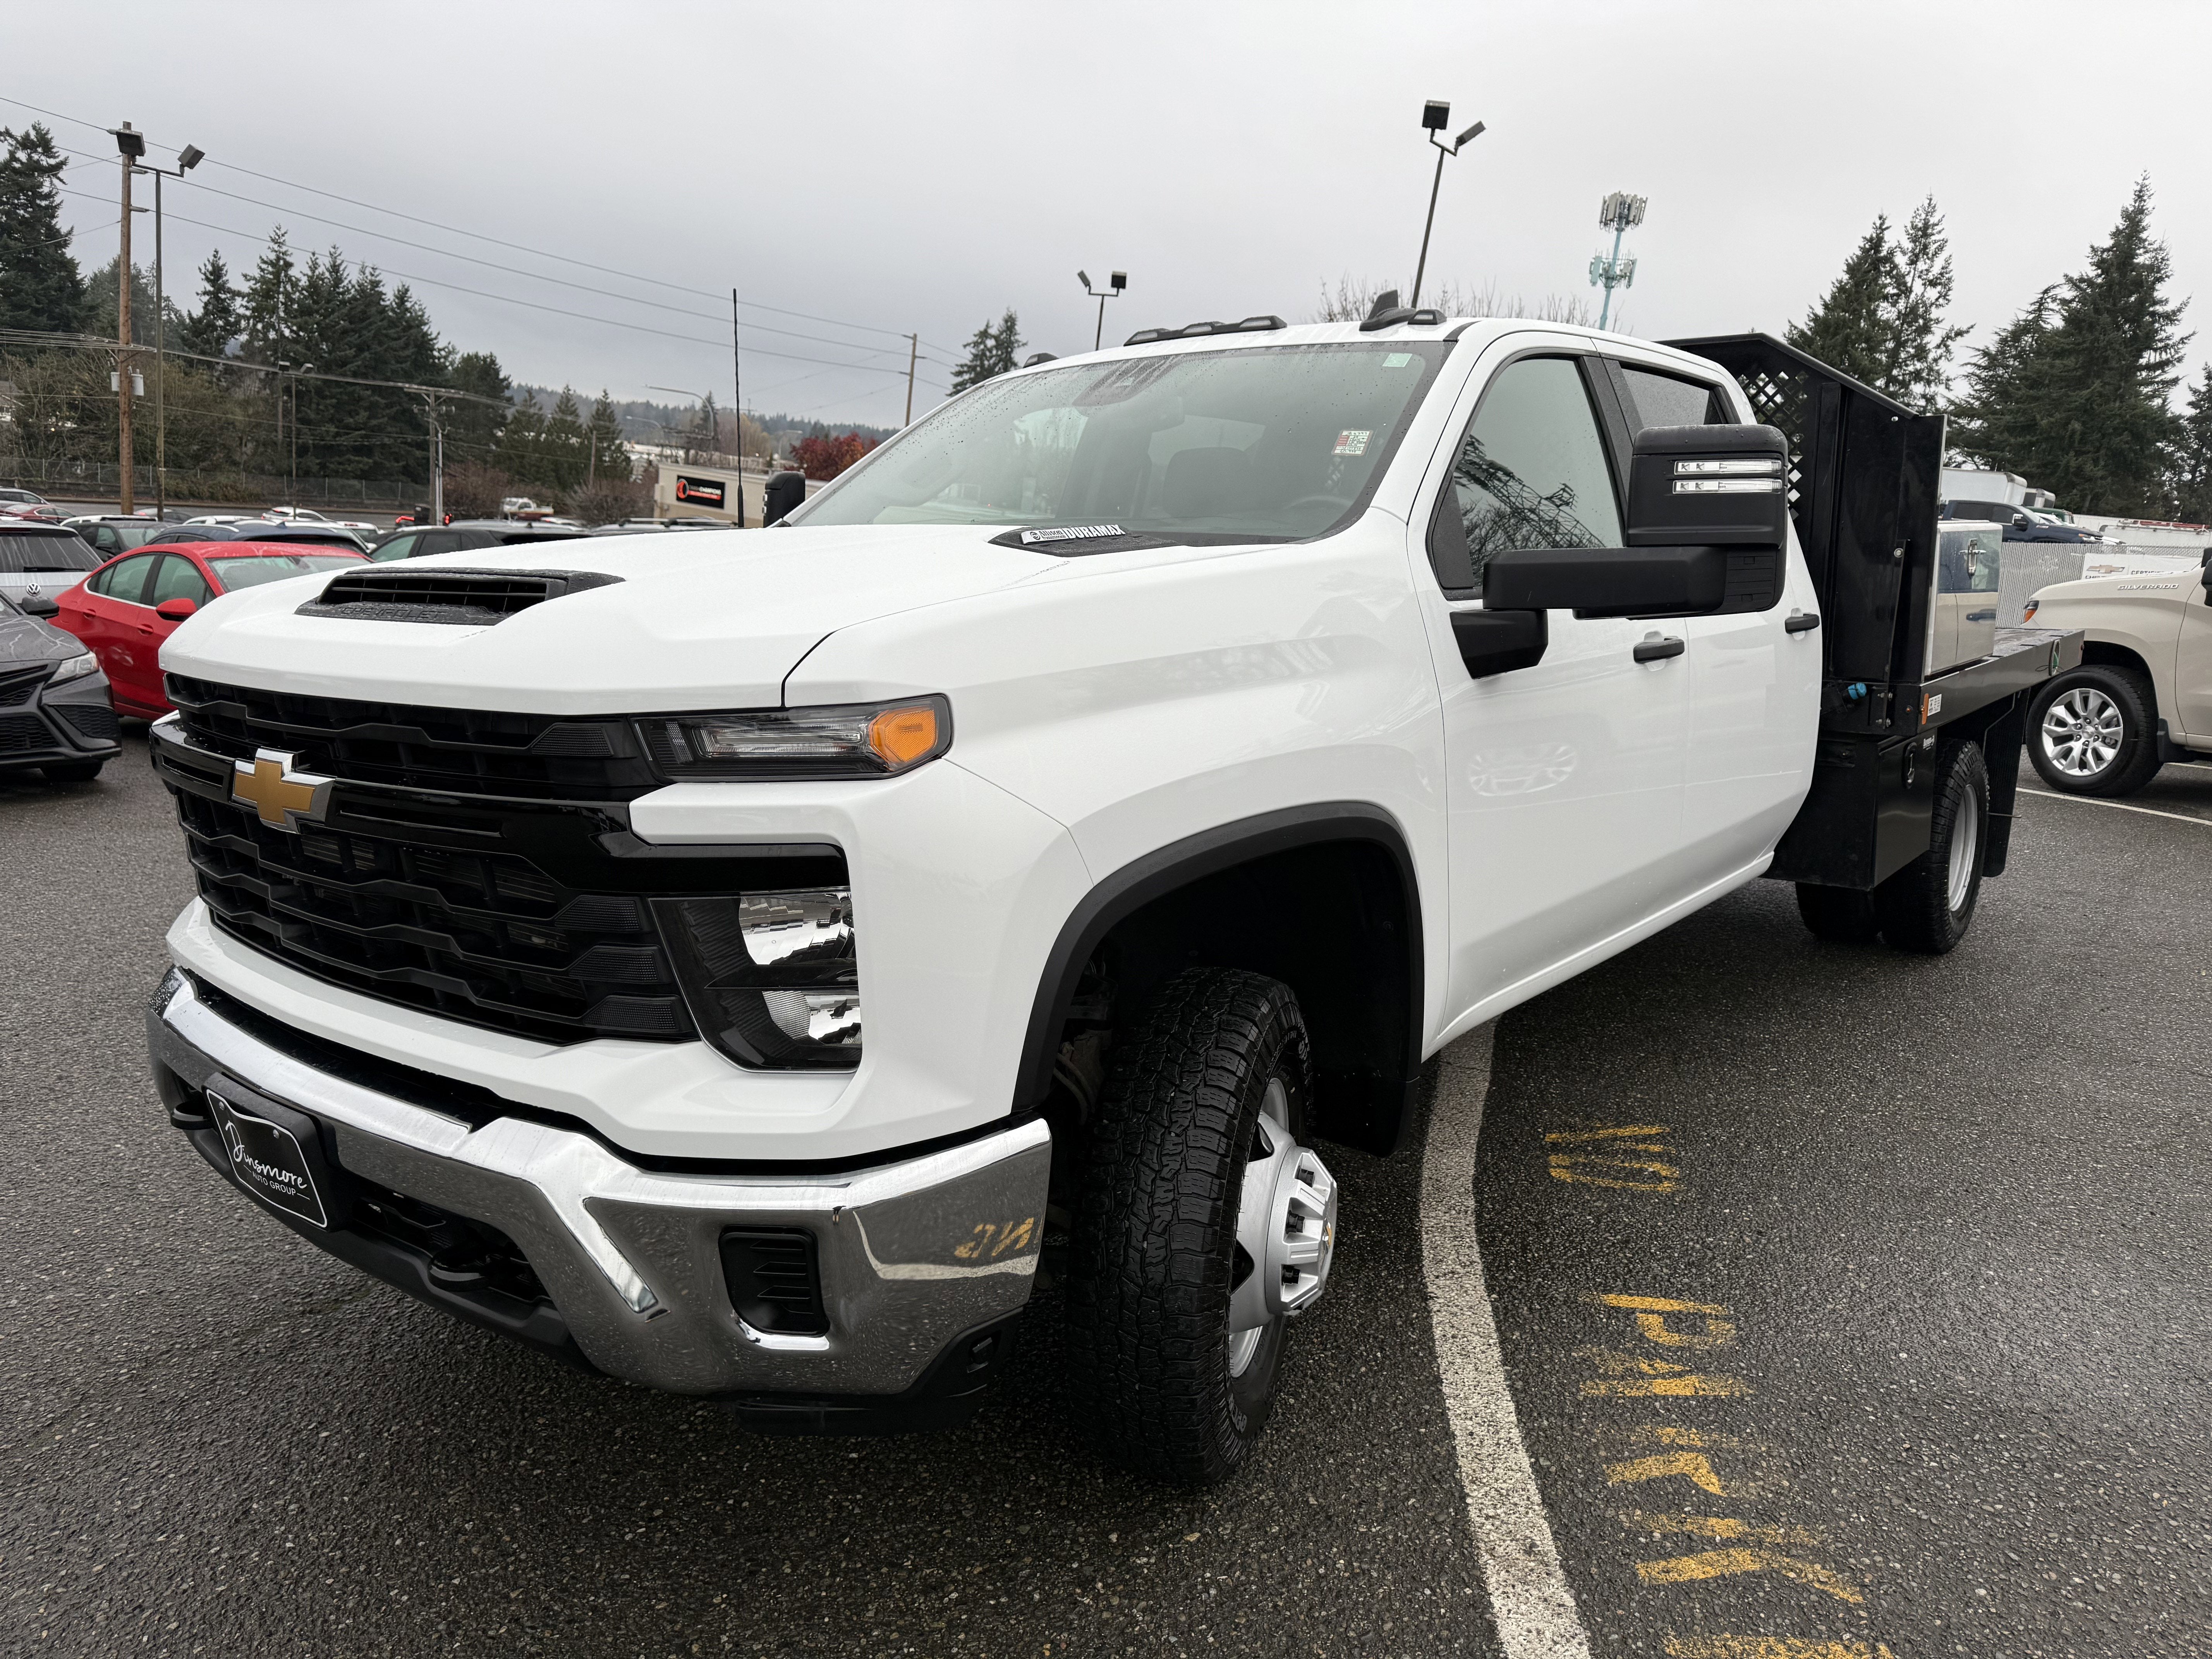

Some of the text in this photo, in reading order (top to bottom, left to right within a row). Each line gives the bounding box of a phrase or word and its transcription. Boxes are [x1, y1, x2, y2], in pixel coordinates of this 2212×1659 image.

[1063, 524, 1126, 539] DURAMAX
[225, 1120, 307, 1189] Dinsmore
[252, 1172, 296, 1196] AUTO GROUP
